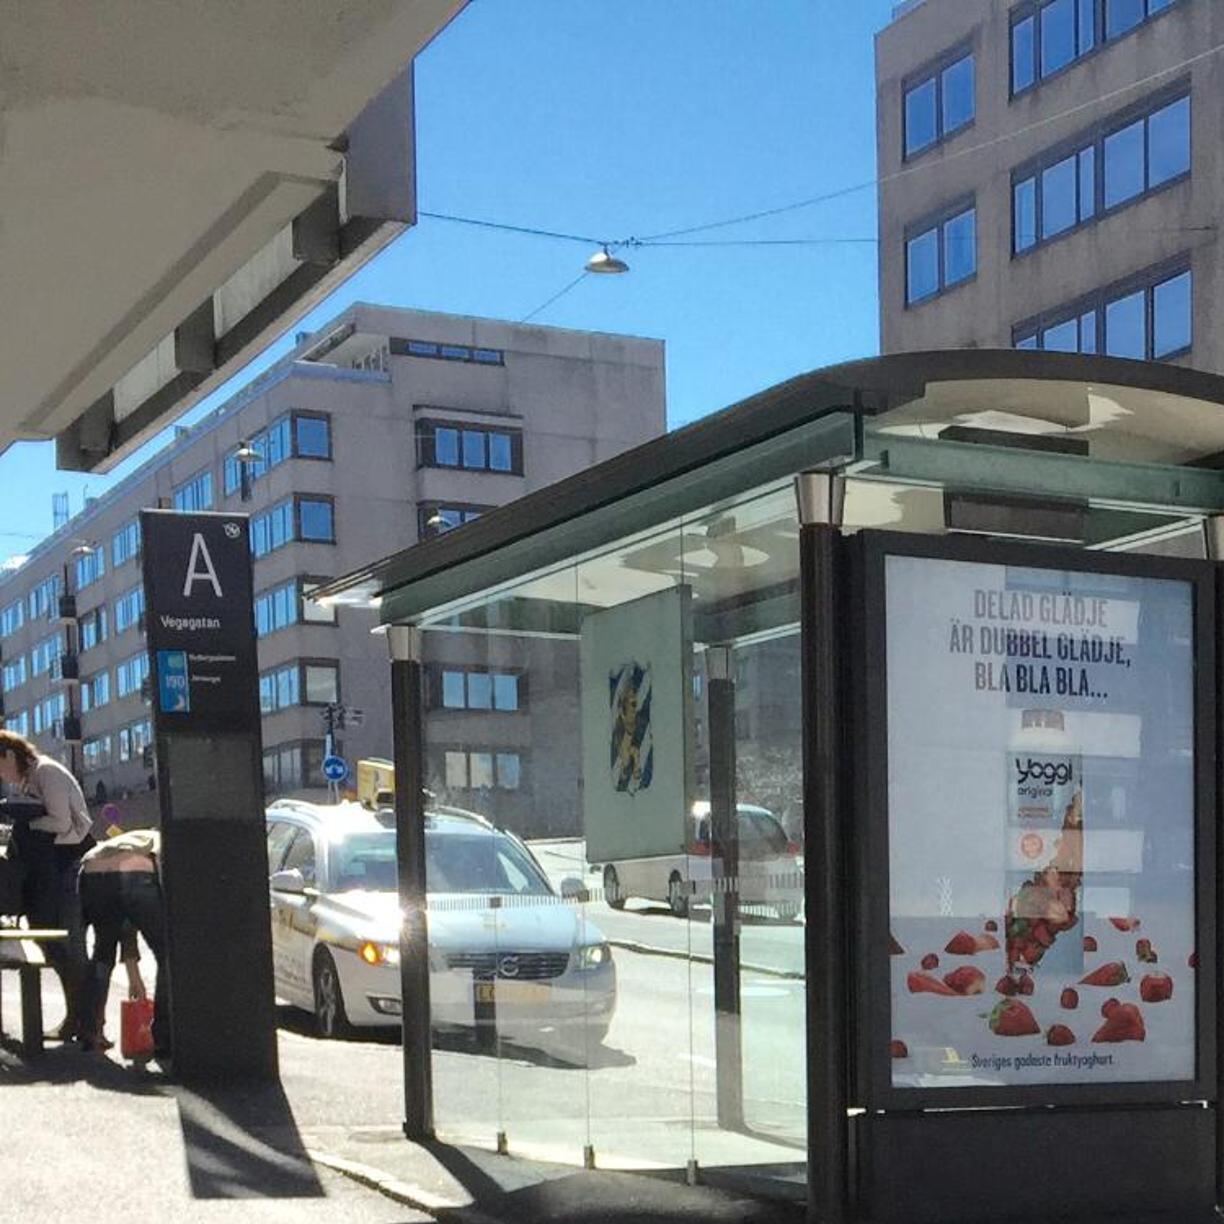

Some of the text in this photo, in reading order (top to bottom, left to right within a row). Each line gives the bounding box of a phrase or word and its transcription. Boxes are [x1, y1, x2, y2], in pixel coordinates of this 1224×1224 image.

[183, 533, 223, 597] A
[160, 615, 221, 631] Vegagatan
[974, 589, 1109, 628] DELAD GLÄDJE
[950, 618, 1131, 668] ÄR DUBBEL GLÄDJE,
[975, 661, 1109, 699] BLA BLA BLA...
[1015, 757, 1073, 786] yoggi
[971, 1053, 1013, 1071] Sveriges
[1014, 1053, 1052, 1070] godaste
